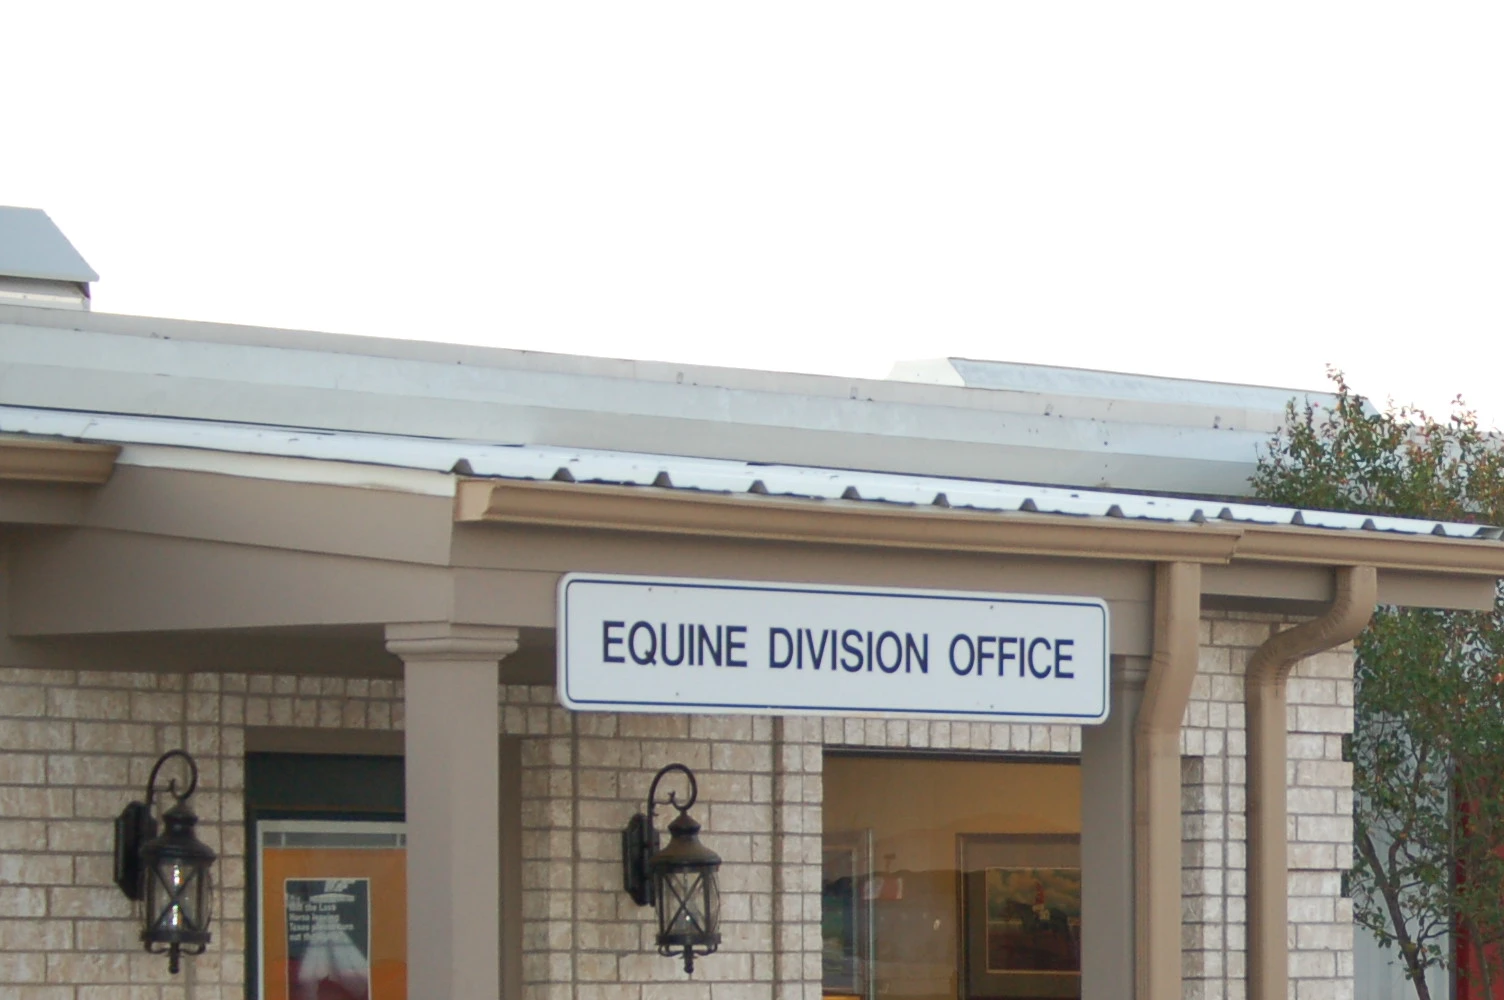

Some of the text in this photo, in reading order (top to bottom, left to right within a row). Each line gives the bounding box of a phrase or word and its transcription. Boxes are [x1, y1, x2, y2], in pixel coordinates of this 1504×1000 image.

[602, 620, 1075, 680] EQUINE DIVISION OFFICE
